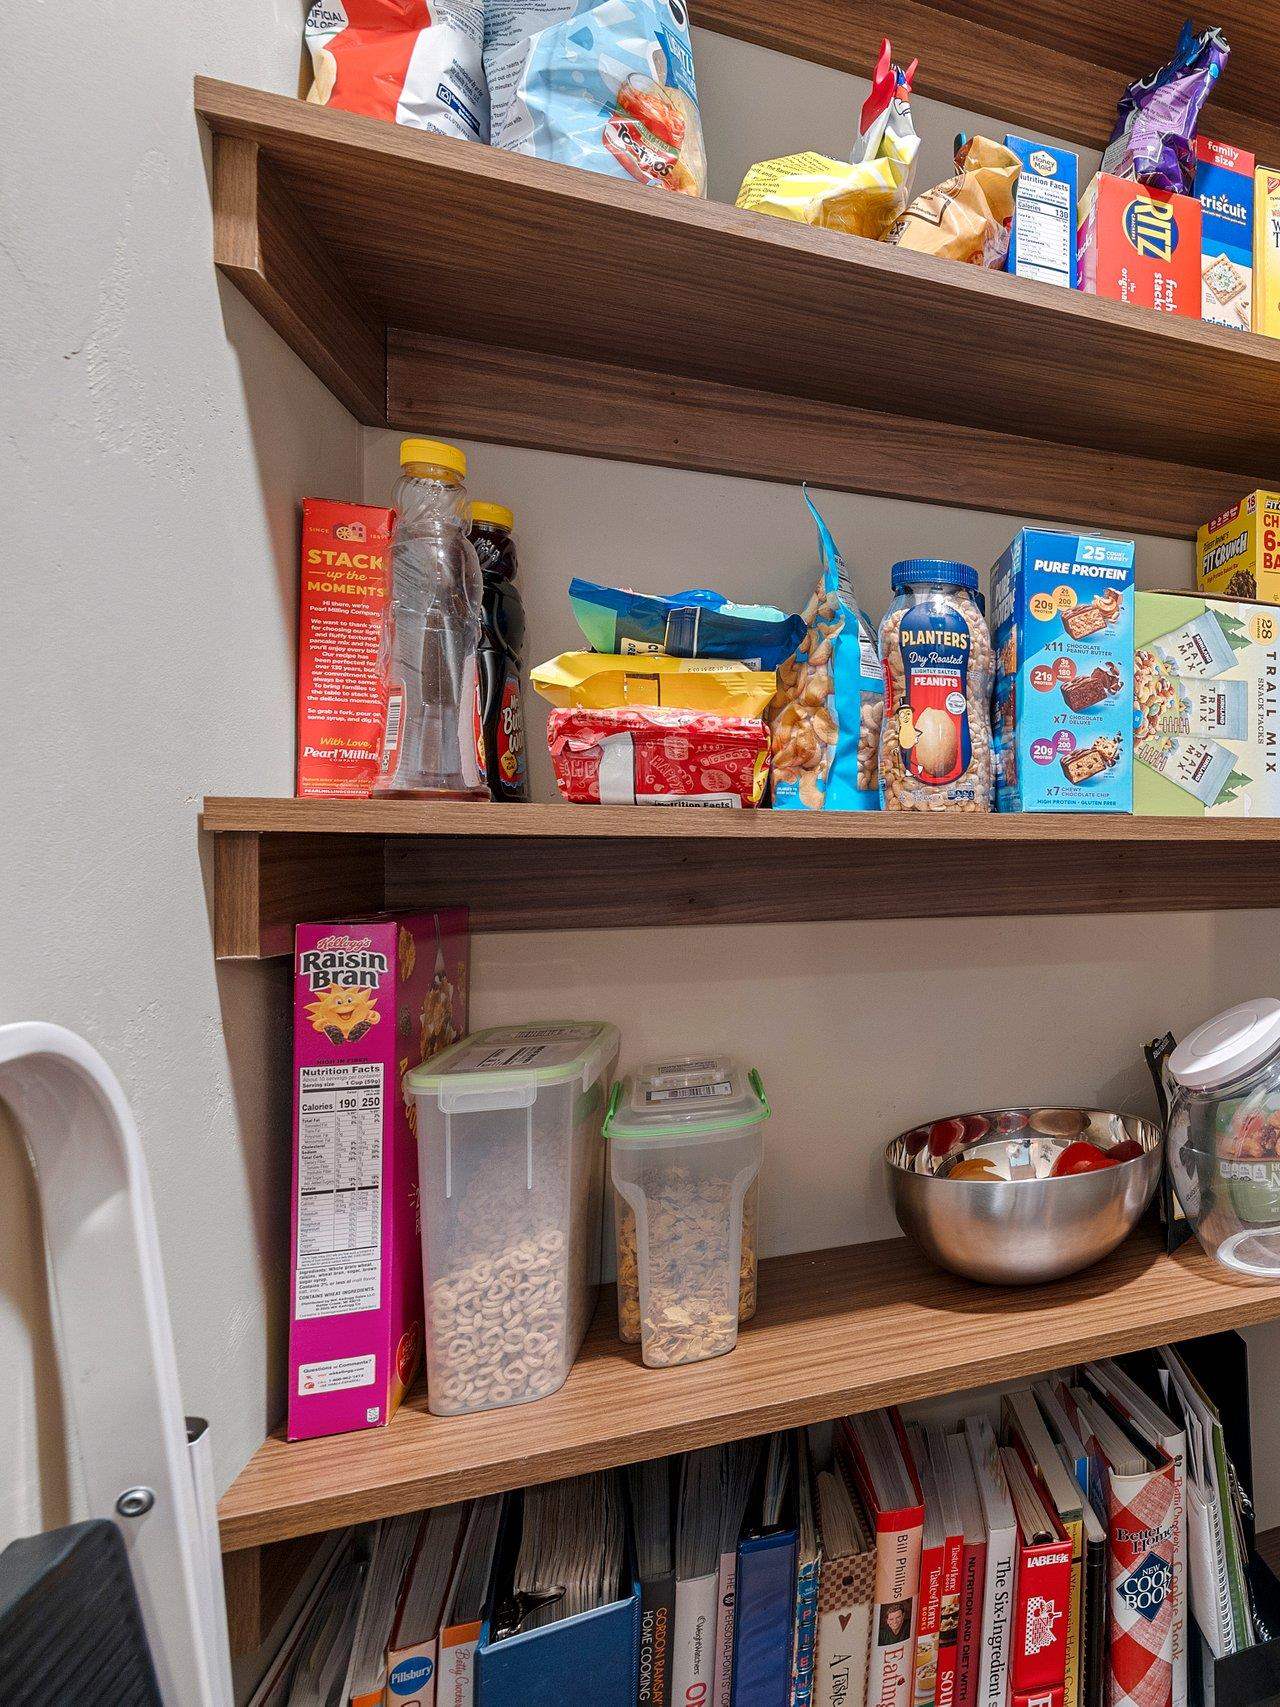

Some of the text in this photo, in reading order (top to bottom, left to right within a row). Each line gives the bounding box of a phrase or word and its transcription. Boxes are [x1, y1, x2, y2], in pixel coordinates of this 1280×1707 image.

[1207, 141, 1239, 160] family
[1032, 155, 1055, 168] Honey
[1214, 155, 1235, 168] size
[1200, 193, 1247, 220] triscuit
[1134, 195, 1174, 264] RITZ
[1165, 279, 1178, 312] fresh
[308, 549, 383, 570] STACK
[1082, 545, 1105, 560] 25
[326, 570, 368, 581] up the
[1034, 560, 1126, 580] PURE PROTEIN
[307, 581, 385, 598] MOMENTS
[1034, 600, 1053, 610] 20g
[901, 630, 967, 649] PLANTERS
[1261, 619, 1273, 640] 28
[1045, 642, 1100, 651] x11 CHOCOLATE
[1182, 632, 1207, 675] TRAIL
[909, 652, 963, 667] Dry Roasted
[1177, 645, 1197, 672] MIX
[914, 677, 958, 687] PEANUTS
[1034, 671, 1053, 681] 21g
[1199, 695, 1208, 722] MIX
[1207, 687, 1217, 731] TRAIL
[1257, 677, 1265, 745] SNACK PACKS
[1266, 651, 1277, 773] TRAIL MIX
[1053, 714, 1103, 724] x7 CHOCOLATE
[304, 747, 338, 758] Pearl
[1034, 745, 1053, 755] 20g
[1176, 744, 1194, 770] MIX
[1180, 743, 1208, 781] TRAIL
[1046, 786, 1060, 796] x7
[317, 936, 372, 951] Kellogg's
[302, 951, 388, 974] Raisin
[312, 970, 379, 990] Bran
[302, 1065, 381, 1077] Nutrition Facts
[302, 1097, 380, 1112] Calories 190 250
[1117, 1525, 1163, 1542] Better
[892, 1534, 909, 1599] Bill Phillips
[1142, 1564, 1161, 1576] NEW
[726, 1573, 736, 1593] THE
[1124, 1564, 1173, 1595] COOK
[1125, 1583, 1173, 1610] BOOK
[654, 1607, 668, 1659] GORDON
[958, 1556, 977, 1702] NUTRITION AND DIET WITH
[987, 1557, 1012, 1698] The Six-Ingredient
[639, 1610, 654, 1701] HOME COOKING
[829, 1654, 852, 1668] A
[391, 1664, 433, 1685] Pillsbury
